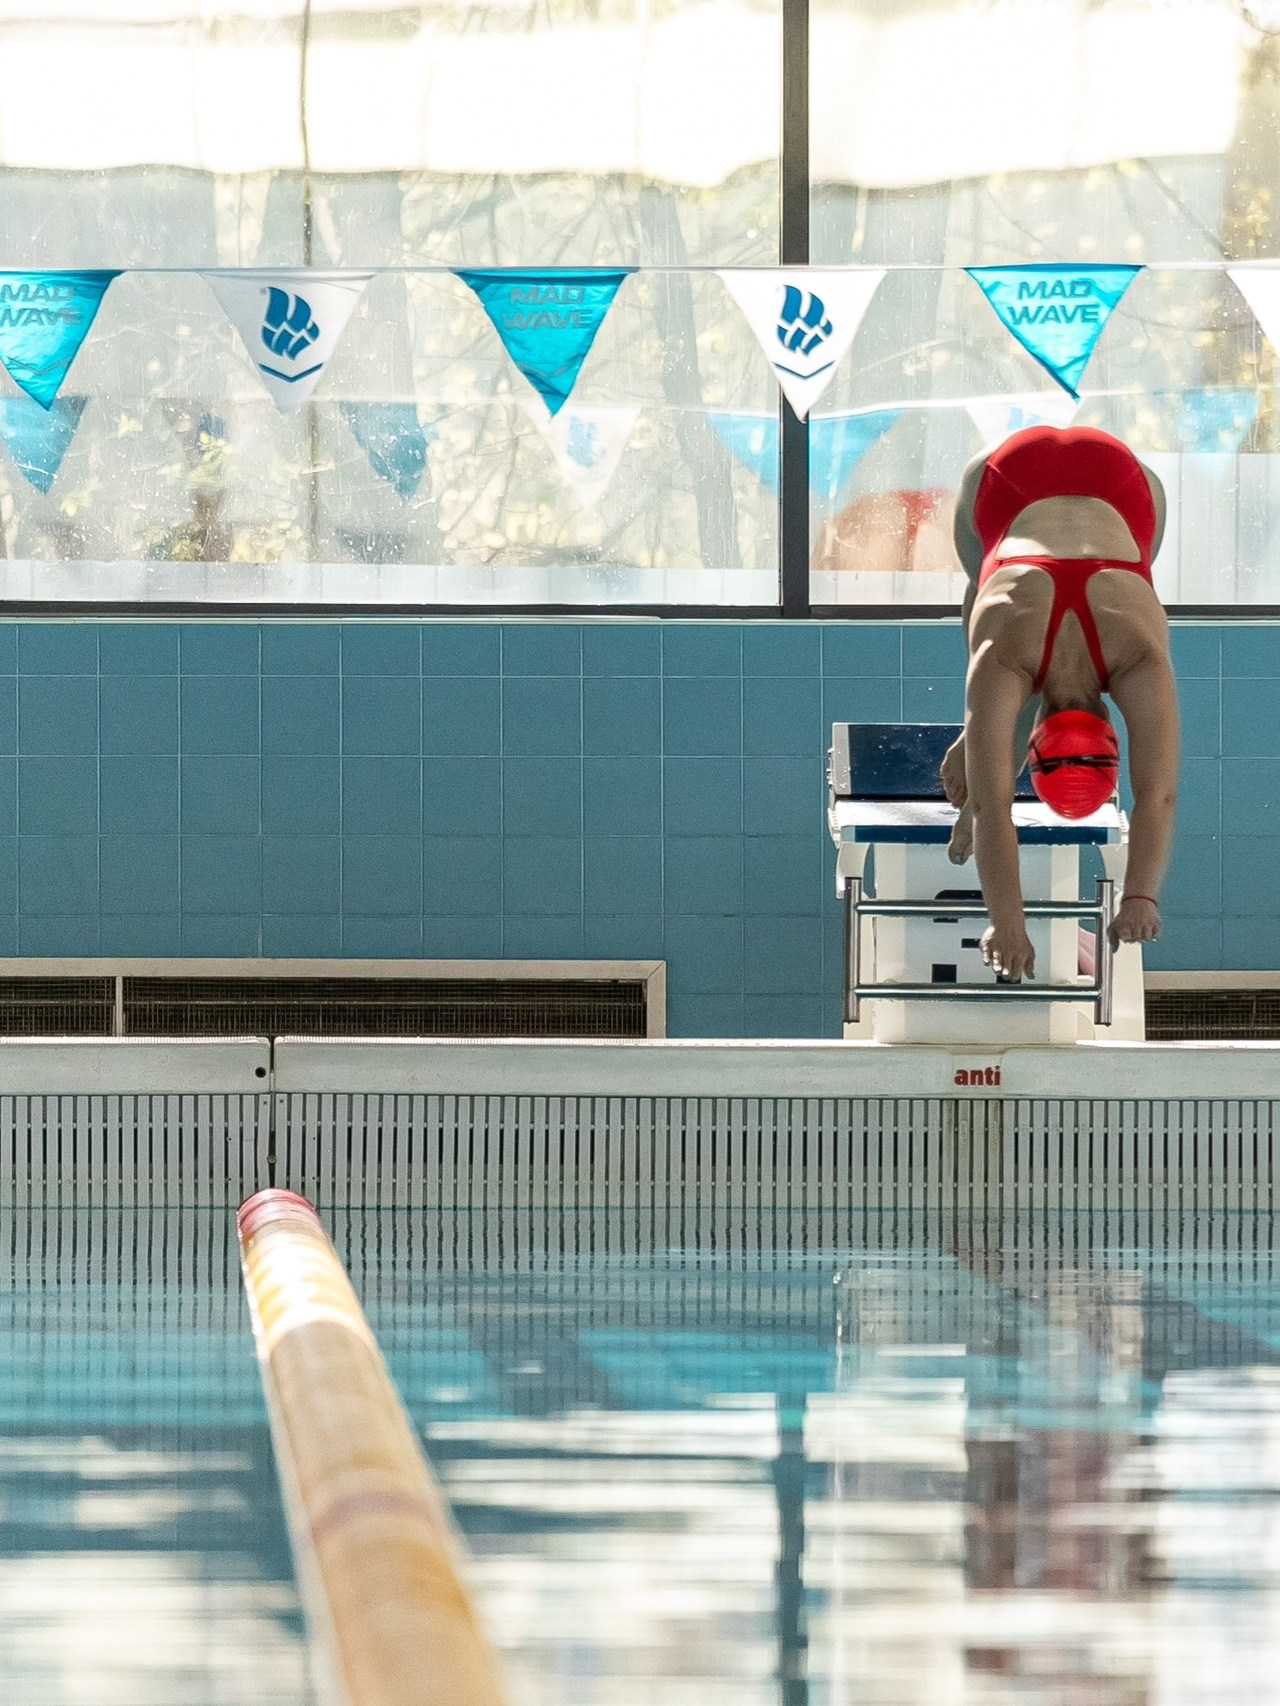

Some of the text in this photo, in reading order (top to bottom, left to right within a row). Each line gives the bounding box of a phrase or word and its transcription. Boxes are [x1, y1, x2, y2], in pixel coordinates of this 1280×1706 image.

[511, 286, 584, 304] MAD
[1017, 279, 1092, 300] MAD
[502, 310, 594, 329] WAVE
[1007, 304, 1099, 325] WAVE
[954, 1065, 1001, 1086] anti
